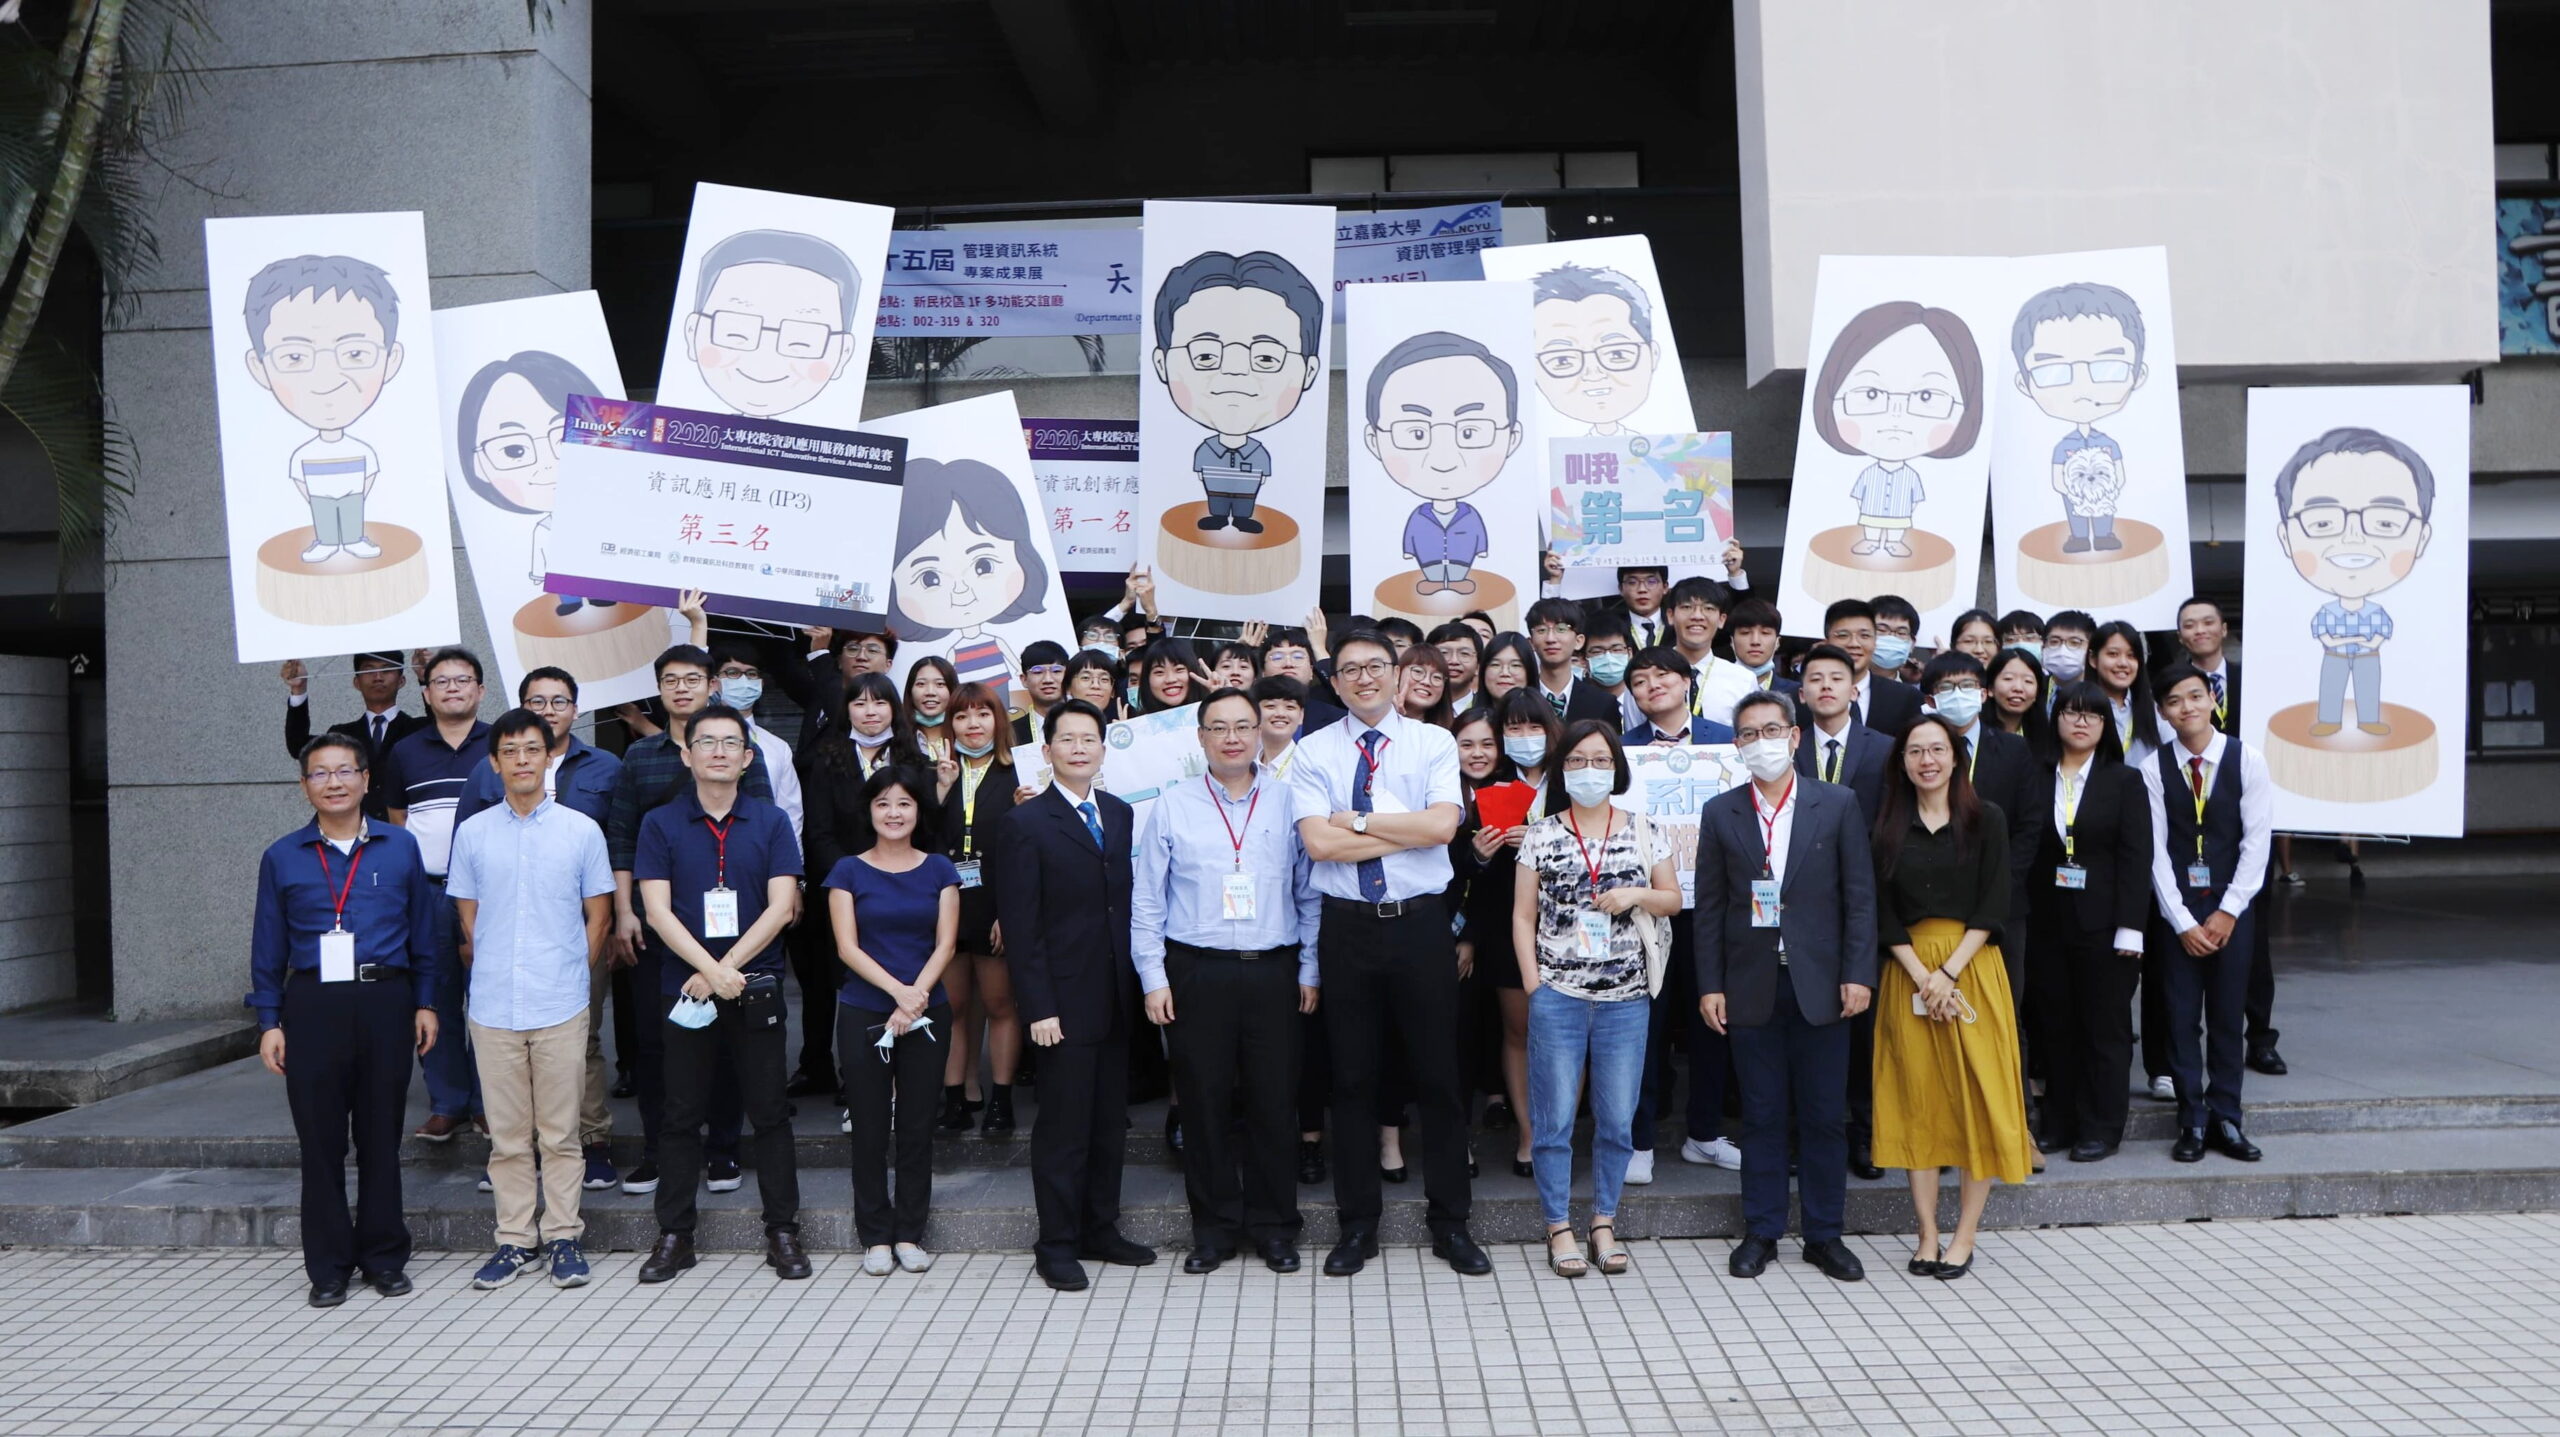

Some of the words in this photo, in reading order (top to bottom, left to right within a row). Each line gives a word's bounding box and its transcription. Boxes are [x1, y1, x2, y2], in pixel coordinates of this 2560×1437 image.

[1337, 219, 1421, 241] 立嘉義大學
[962, 243, 1059, 258] 管理資訊系統
[963, 266, 1043, 280] 專案成果展
[1106, 263, 1133, 294] 天
[913, 295, 965, 308] 新民校區
[968, 296, 981, 307] 1F
[985, 295, 1064, 308] 多功能交誼廳
[913, 315, 960, 326] D02-319
[966, 316, 974, 326] &
[980, 316, 1000, 326] 320
[1074, 312, 1133, 325] Department
[574, 418, 647, 438] InnoServe
[667, 420, 721, 449] 2020
[722, 427, 894, 463] 大專校院資訊應用服務創新競賽
[1034, 429, 1080, 450] 2020
[720, 443, 766, 456] International
[767, 448, 781, 457] ICT
[781, 450, 817, 462] Innovative
[818, 455, 846, 466] Services
[846, 459, 873, 470] Awards
[1565, 452, 1619, 484] 叫我
[647, 470, 762, 505] 資訊應用組
[768, 488, 812, 513] (IP3)
[1034, 474, 1140, 494] 資訊創新應
[1052, 506, 1131, 534] 第一名
[1581, 488, 1705, 545] 第一名
[677, 512, 771, 552] 第三名
